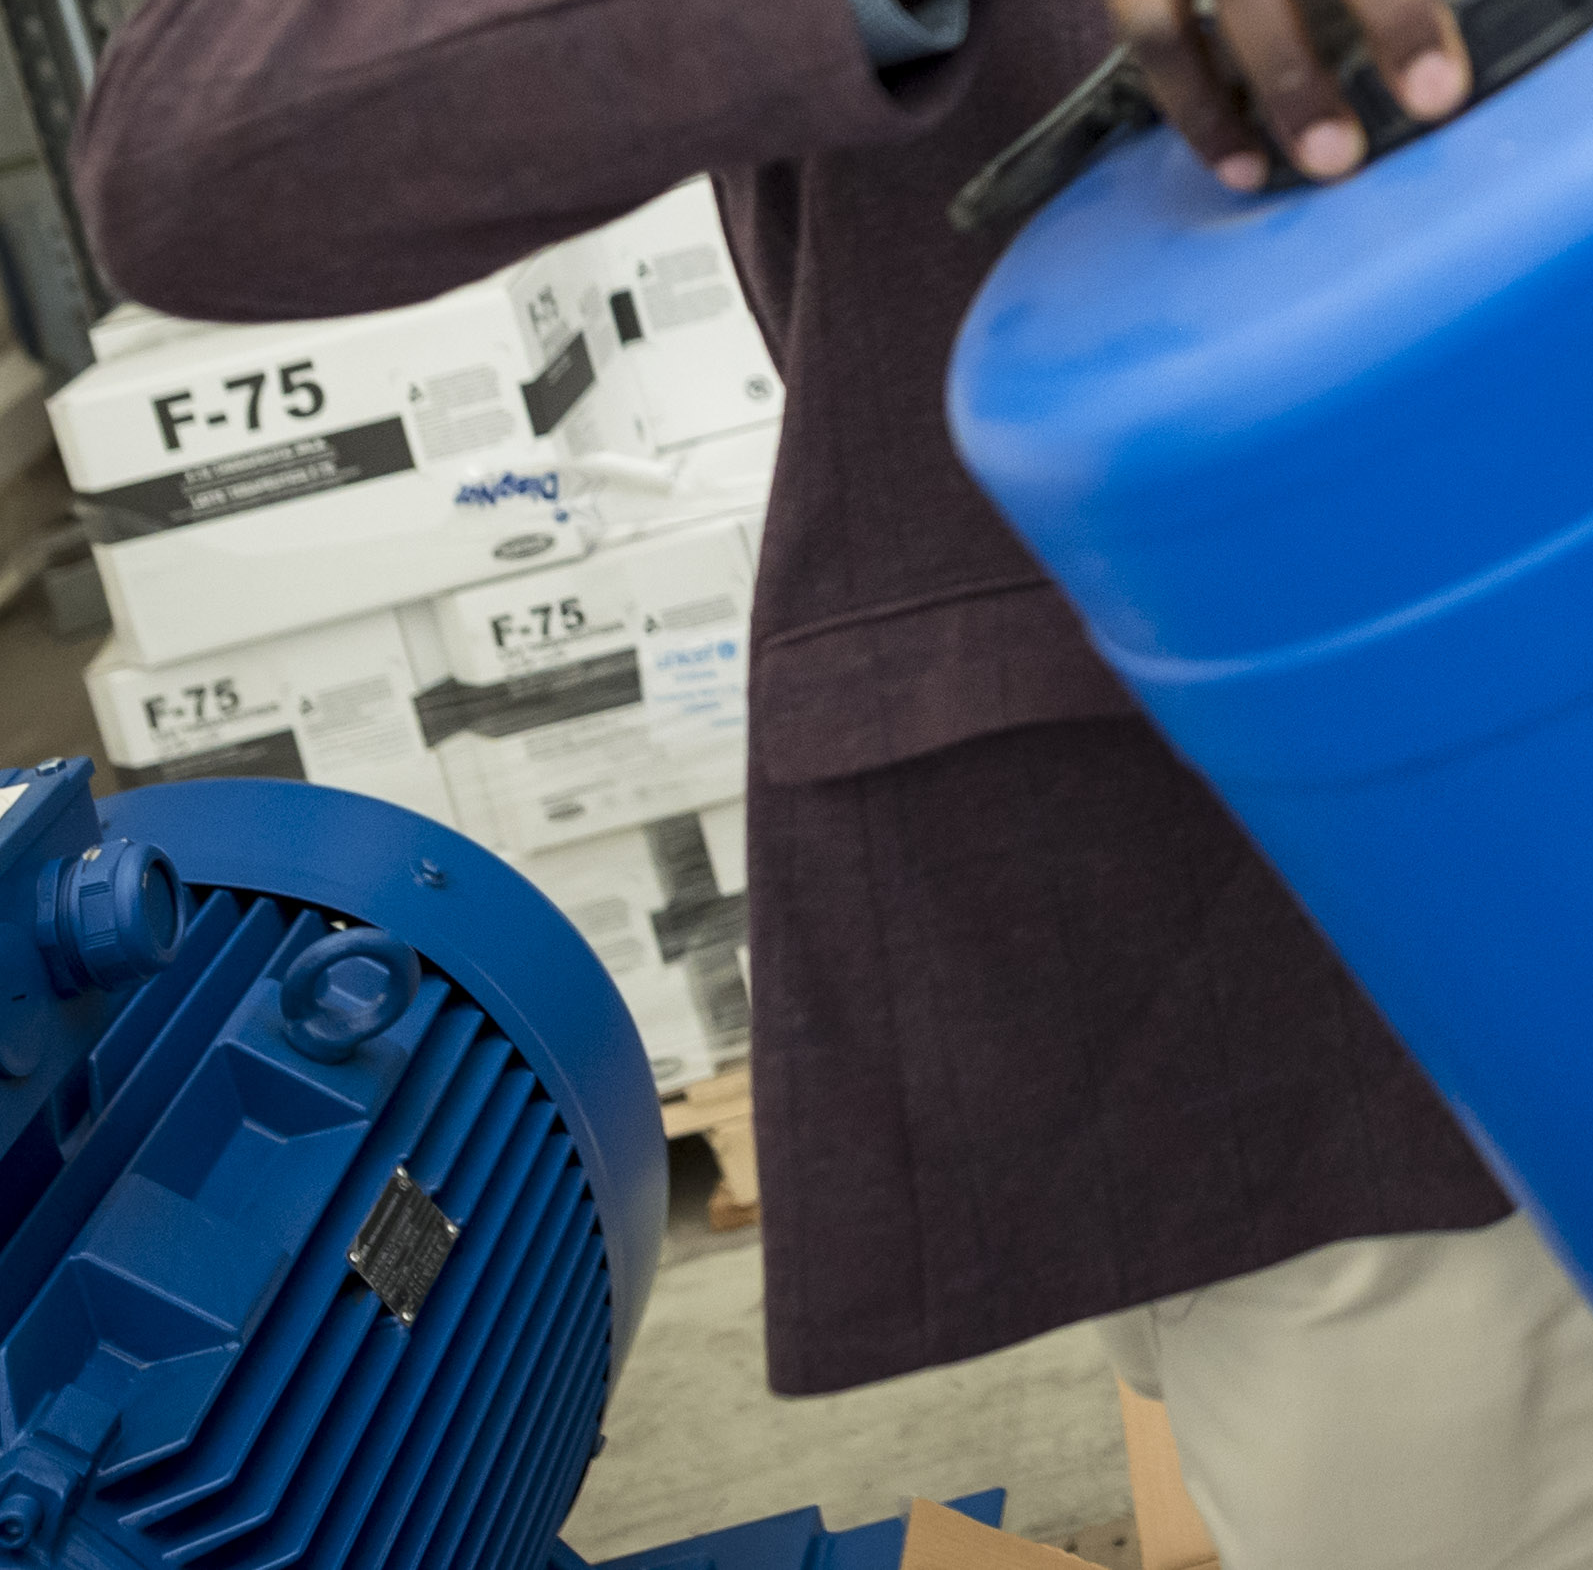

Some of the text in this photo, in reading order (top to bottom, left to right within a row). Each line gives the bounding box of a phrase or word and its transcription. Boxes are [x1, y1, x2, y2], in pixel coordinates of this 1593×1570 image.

[153, 360, 325, 450] F-75
[490, 597, 586, 647] F-75
[144, 676, 240, 730] F-75
